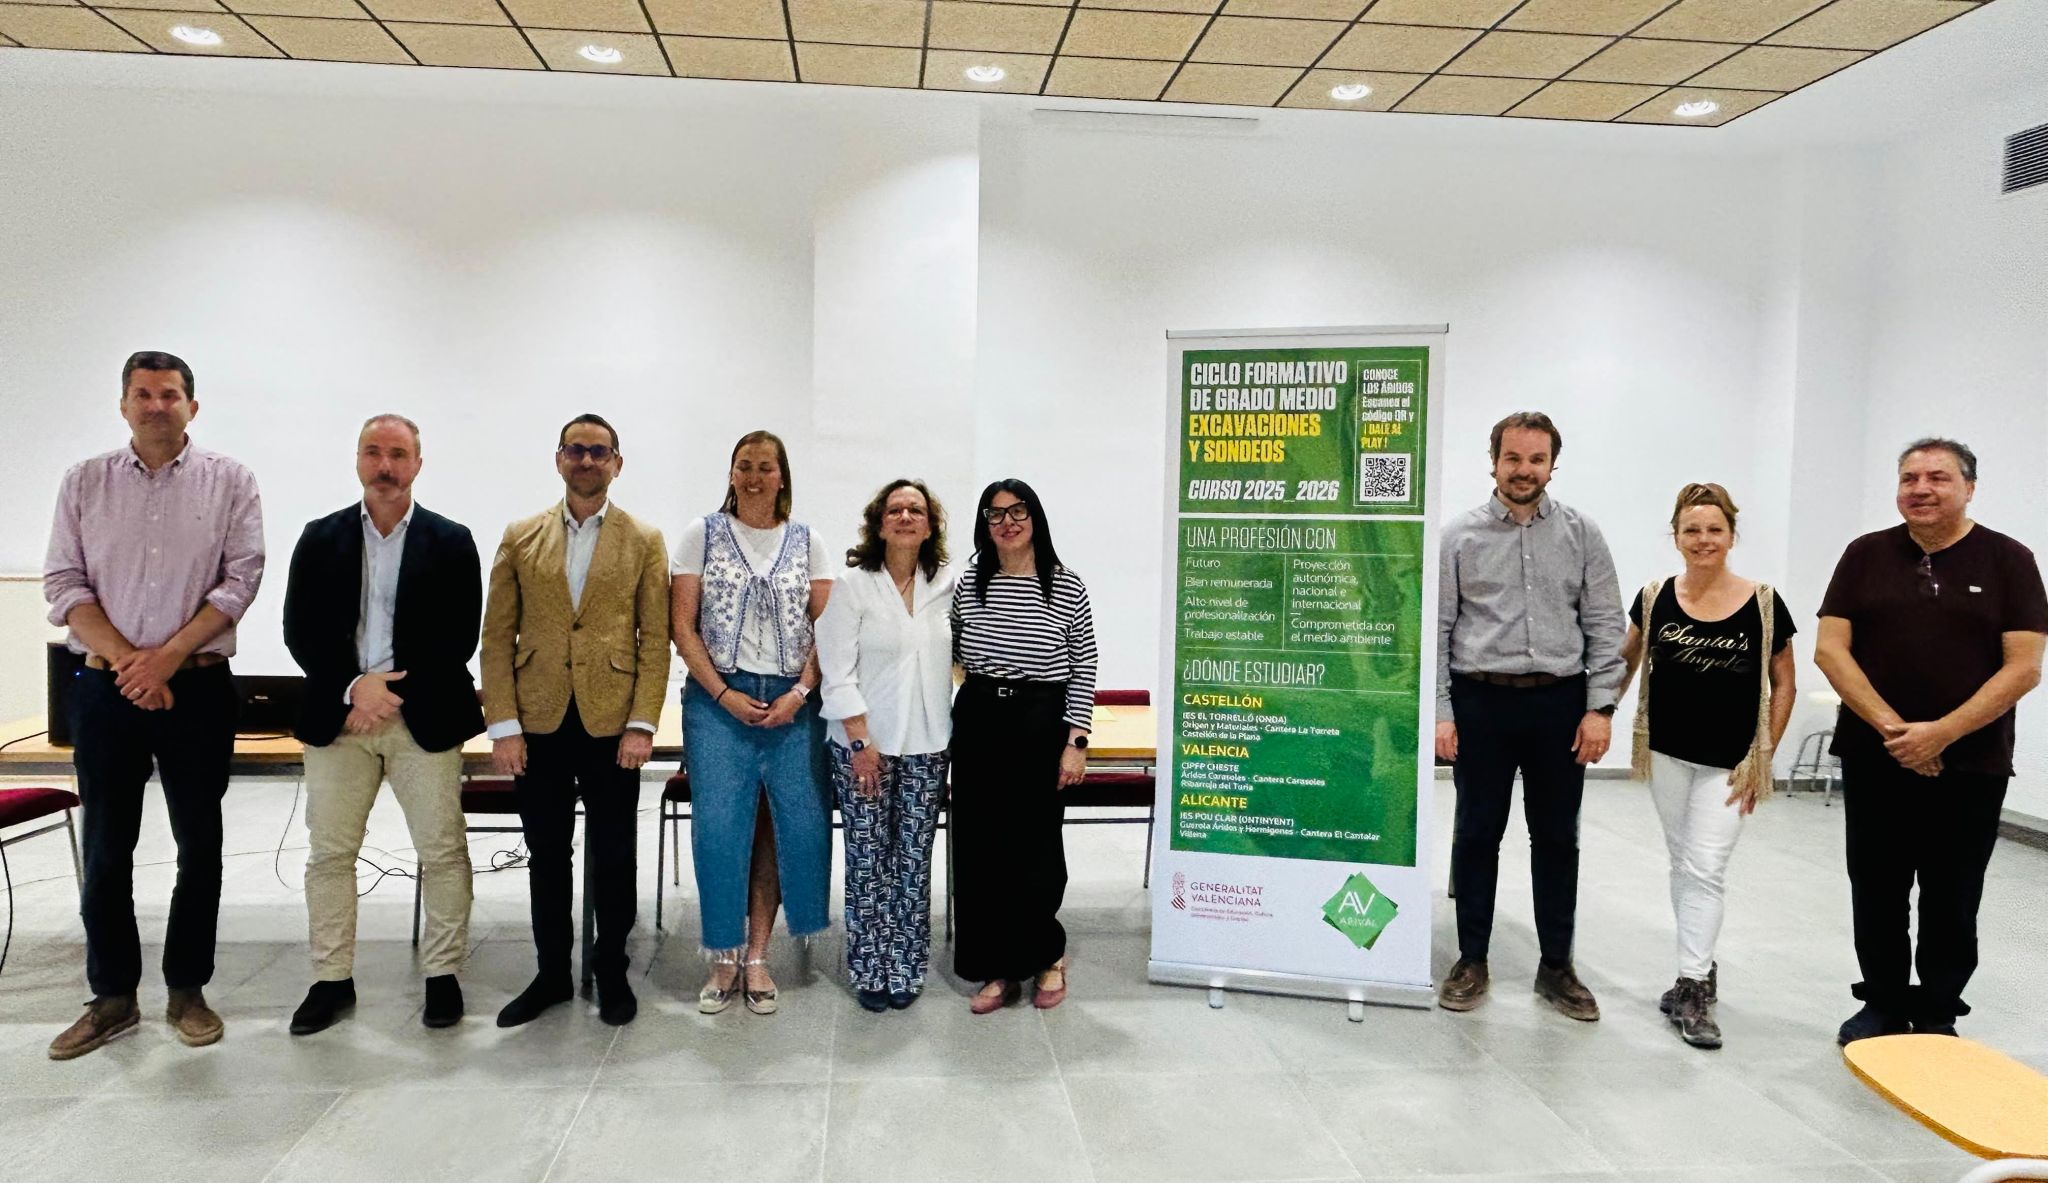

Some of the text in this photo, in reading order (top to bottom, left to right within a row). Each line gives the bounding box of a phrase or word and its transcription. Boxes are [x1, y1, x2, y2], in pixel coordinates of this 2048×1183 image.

[1190, 360, 1347, 385] CICLO FORMATIVO
[1363, 368, 1399, 381] CONOCE
[1362, 382, 1380, 394] LOS
[1189, 387, 1337, 411] DE GRADO MEDIO
[1394, 409, 1407, 422] QR
[1408, 411, 1415, 423] y
[1189, 413, 1321, 437] EXCAVACIONES
[1188, 439, 1285, 463] Y SONDEOS
[1188, 479, 1242, 501] CURSO
[1187, 523, 1336, 550] UNA PROFESIÓN CON
[1186, 557, 1221, 568] Futuro
[1293, 558, 1351, 572] Proyección
[1185, 576, 1273, 589] Bien remunerada
[1292, 586, 1347, 597] nacional e
[1184, 596, 1249, 608] Alto nivel de
[1292, 599, 1361, 610] internacional
[1184, 609, 1276, 622] profesionalización
[1291, 617, 1395, 632] Comprometida con
[1185, 628, 1265, 641] Trabajo estable
[1291, 632, 1392, 645] el medio ambiente
[1658, 622, 1749, 651] Santa's
[1183, 657, 1326, 685] ¿DÓNDE ESTUDIAR?
[1183, 693, 1263, 708] CASTELLÓN
[1182, 712, 1197, 720] IES
[1197, 713, 1207, 721] EL
[1255, 715, 1287, 725] (ONDA)
[1182, 720, 1209, 731] Origen
[1210, 723, 1216, 731] y
[1216, 722, 1259, 732] Materiales
[1264, 724, 1297, 734] Cantera
[1298, 726, 1309, 735] La
[1182, 729, 1262, 741] Castellón de la Plana
[1182, 743, 1250, 759] VALENCIA
[1181, 762, 1240, 773] CIPFP CHESTE
[1218, 782, 1232, 790] del
[1252, 774, 1285, 784] Cantera
[1286, 776, 1326, 787] Carasoles
[1180, 794, 1248, 809] ALICANTE
[1180, 812, 1194, 820] IES
[1194, 812, 1213, 821] POU
[1214, 813, 1238, 823] CLAR
[1300, 828, 1333, 838] Cantera
[1190, 881, 1264, 896] GENERALITAT
[1191, 892, 1262, 907] VALENCIANA
[1338, 890, 1376, 915] AV
